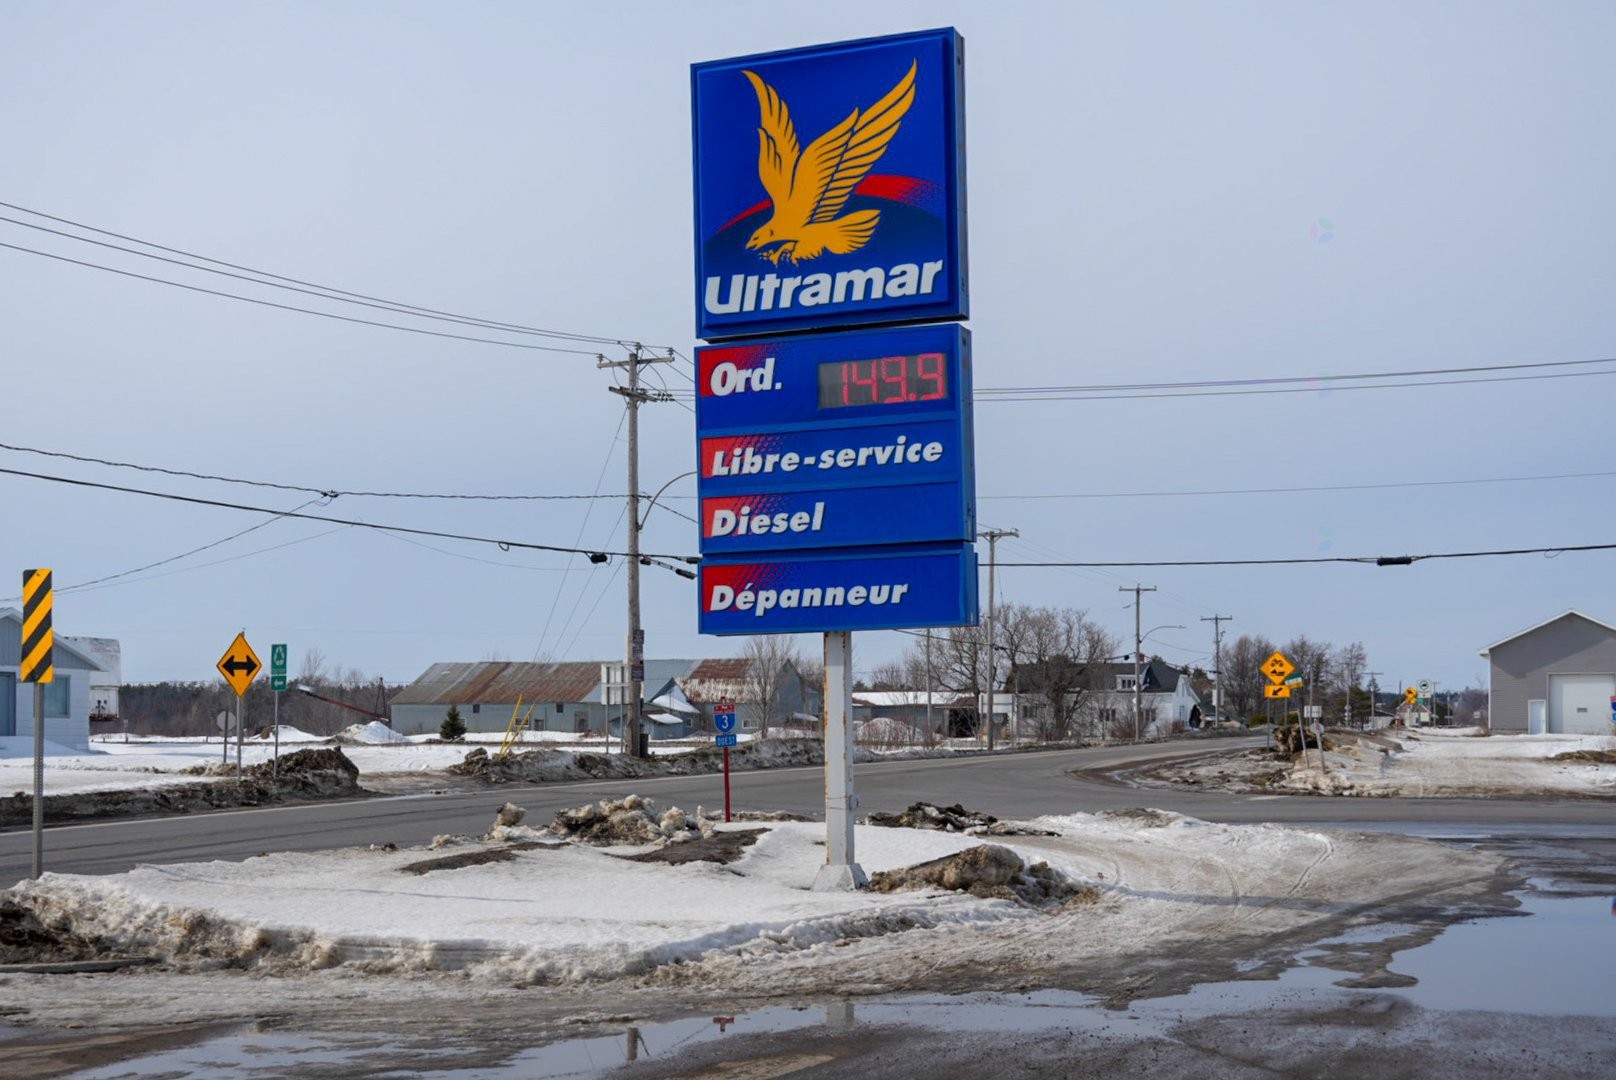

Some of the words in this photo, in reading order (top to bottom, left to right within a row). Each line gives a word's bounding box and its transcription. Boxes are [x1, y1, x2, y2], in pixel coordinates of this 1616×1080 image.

[705, 260, 943, 314] Ultramar
[711, 358, 782, 396] Ord.
[842, 353, 944, 404] 149.9
[712, 435, 943, 476] Libre-service
[712, 502, 825, 536] Diesel
[710, 583, 908, 616] Dépanneur
[721, 715, 729, 729] 3
